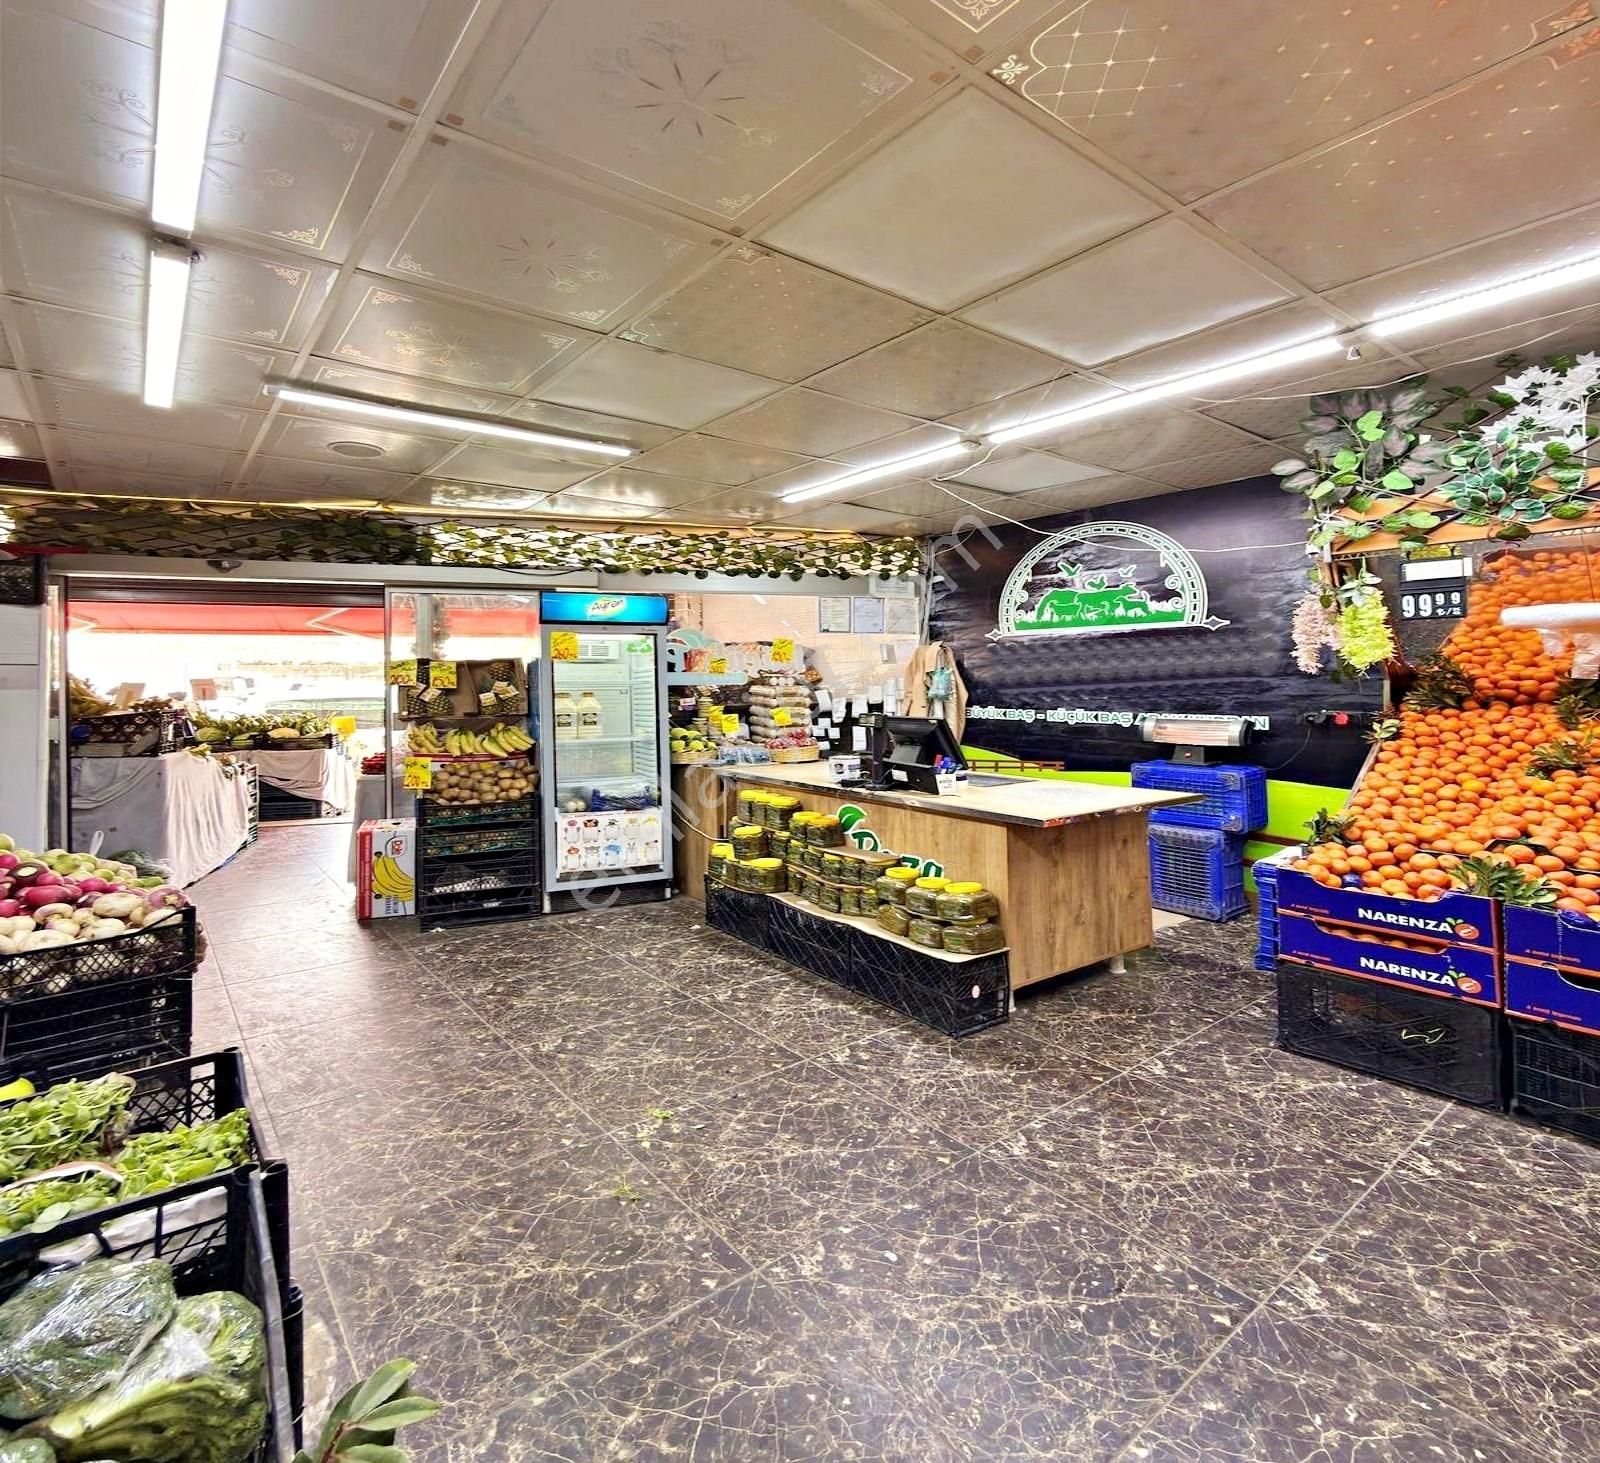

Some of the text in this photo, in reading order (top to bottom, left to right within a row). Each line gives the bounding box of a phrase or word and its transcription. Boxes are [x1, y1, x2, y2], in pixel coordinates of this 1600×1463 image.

[1006, 708, 1036, 723] BAŞ
[1046, 707, 1098, 725] KÜÇÜK
[1098, 711, 1134, 727] BAŞ
[1357, 907, 1454, 934] NARENZA
[1359, 956, 1456, 987] NARENZA
